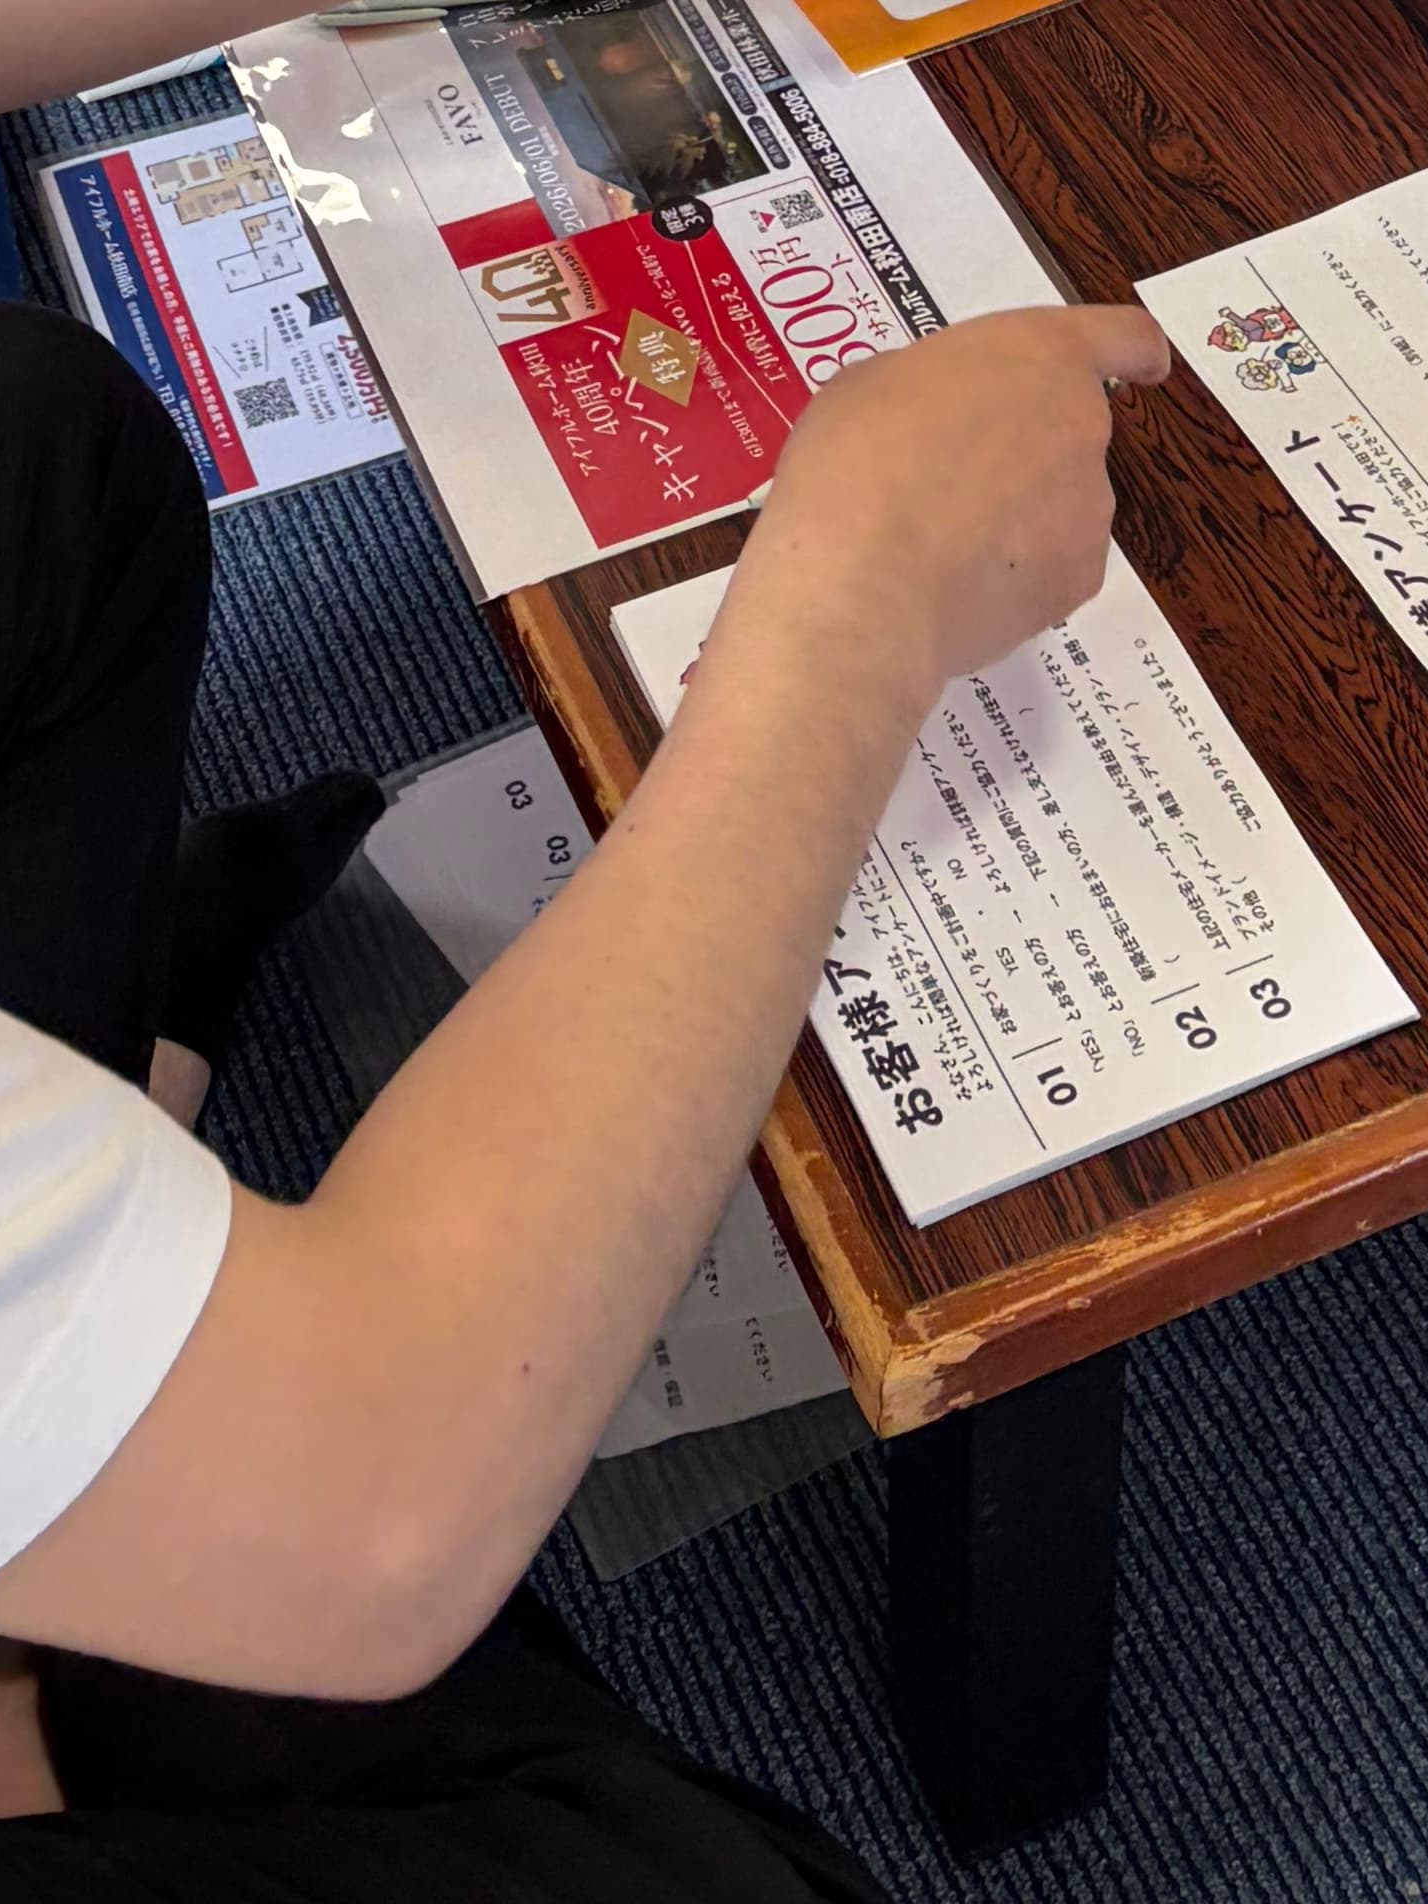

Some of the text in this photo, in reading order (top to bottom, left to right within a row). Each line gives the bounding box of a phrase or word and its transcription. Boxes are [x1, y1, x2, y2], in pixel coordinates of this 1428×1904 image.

[431, 82, 488, 146] FAVO
[478, 69, 537, 133] DEBUT
[512, 133, 595, 233] 2026/06/01
[657, 206, 689, 234] 限定
[550, 243, 605, 311] anniversary
[817, 250, 906, 341] サポート
[631, 327, 692, 386] 特典
[700, 270, 799, 386] 工事費に使える
[514, 341, 606, 477] アイフルホーム秋田
[556, 354, 630, 439] 40周年
[567, 317, 712, 507] キャンペーン
[503, 777, 534, 811] 03
[934, 707, 1053, 881] 下記の質問にご協力ください
[544, 834, 572, 866] 03
[895, 835, 1023, 1037] お家づくりをご計画中ですか？
[944, 856, 1022, 976] YES NO
[800, 920, 950, 1141] お客様ア
[841, 872, 980, 1104] みなさん、こんにちは。アイフル
[1171, 1003, 1222, 1054] 02
[1245, 974, 1297, 1024] 03
[1032, 1061, 1083, 1111] 01
